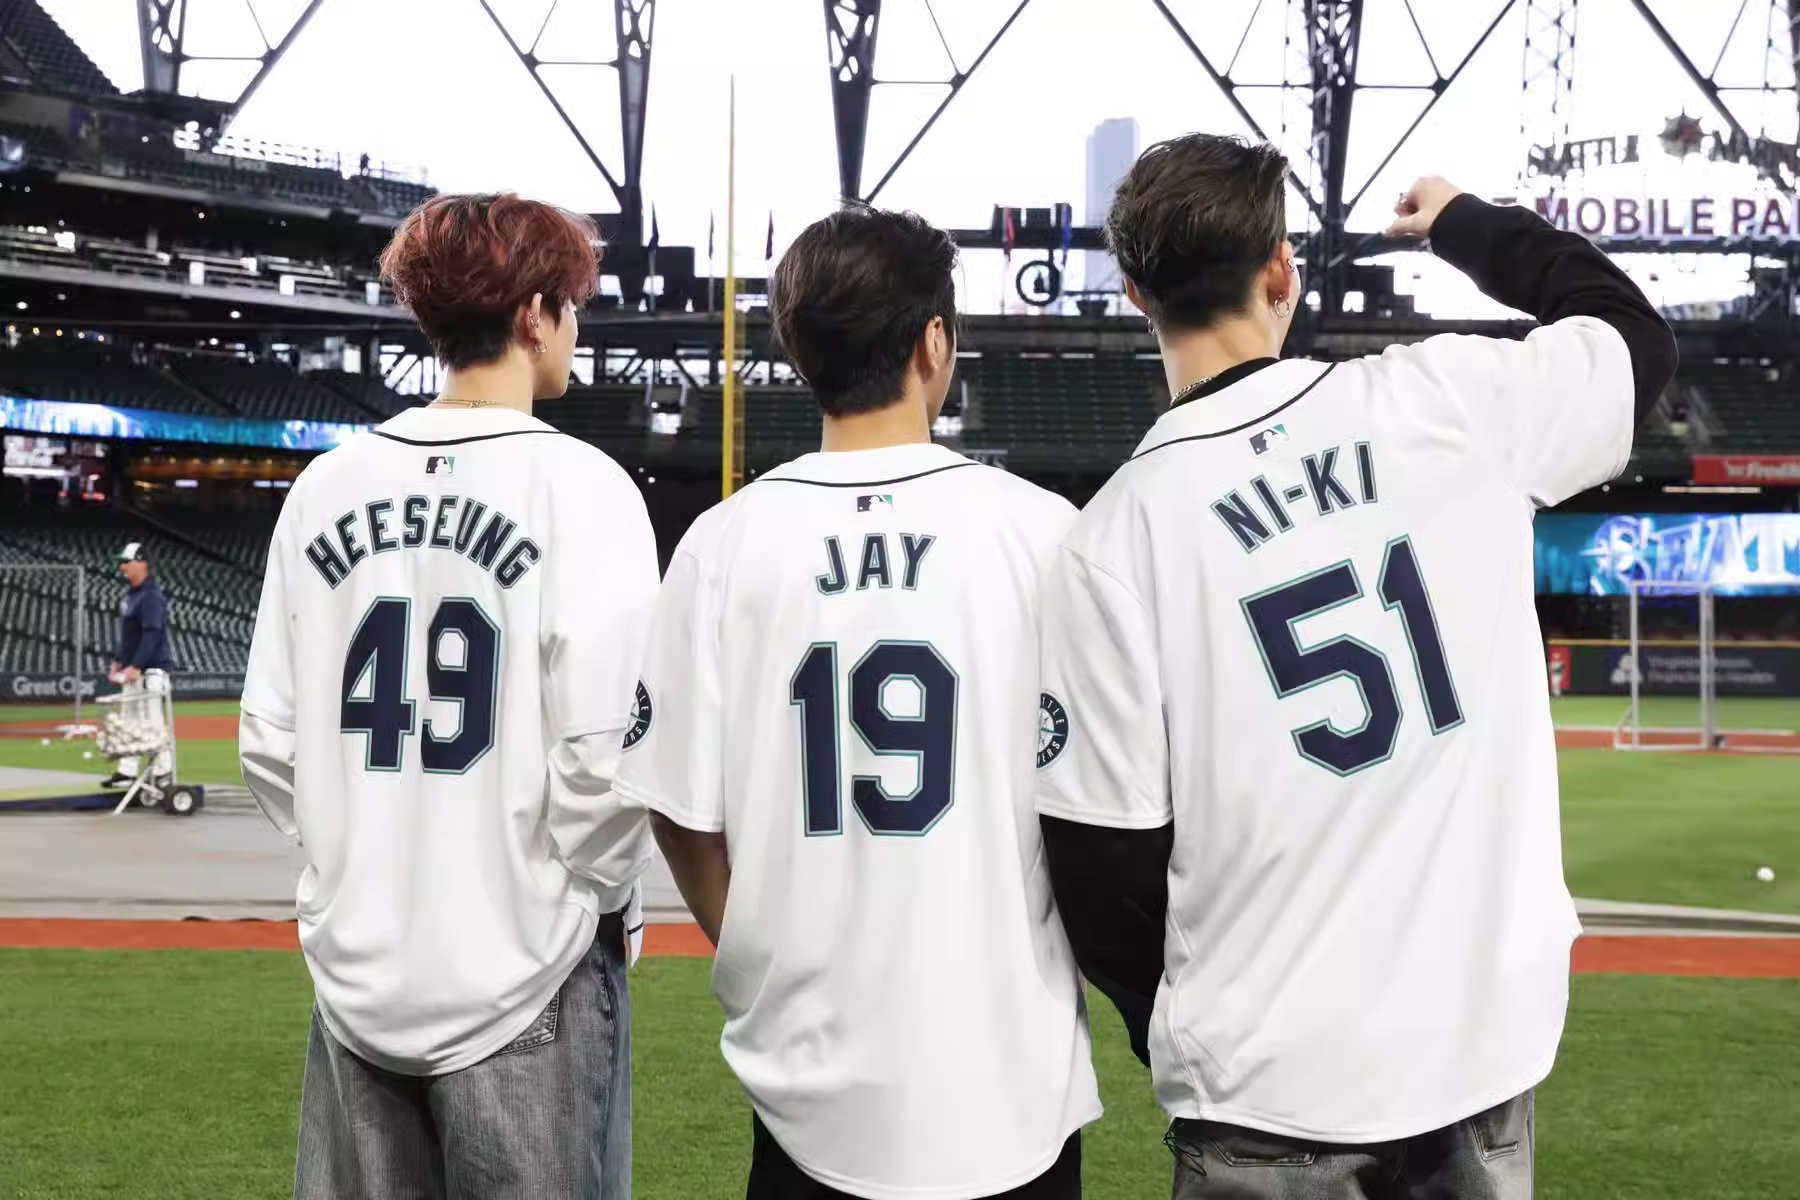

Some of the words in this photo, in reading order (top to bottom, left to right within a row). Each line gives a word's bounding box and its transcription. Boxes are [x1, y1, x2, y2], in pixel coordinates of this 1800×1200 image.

[1732, 198, 1800, 234] PA
[304, 495, 542, 590] HEESEUNG
[1209, 441, 1378, 554] NI-KI
[815, 533, 937, 596] JAY
[340, 596, 501, 775] 49
[1238, 533, 1466, 778] 51
[789, 639, 960, 837] 19
